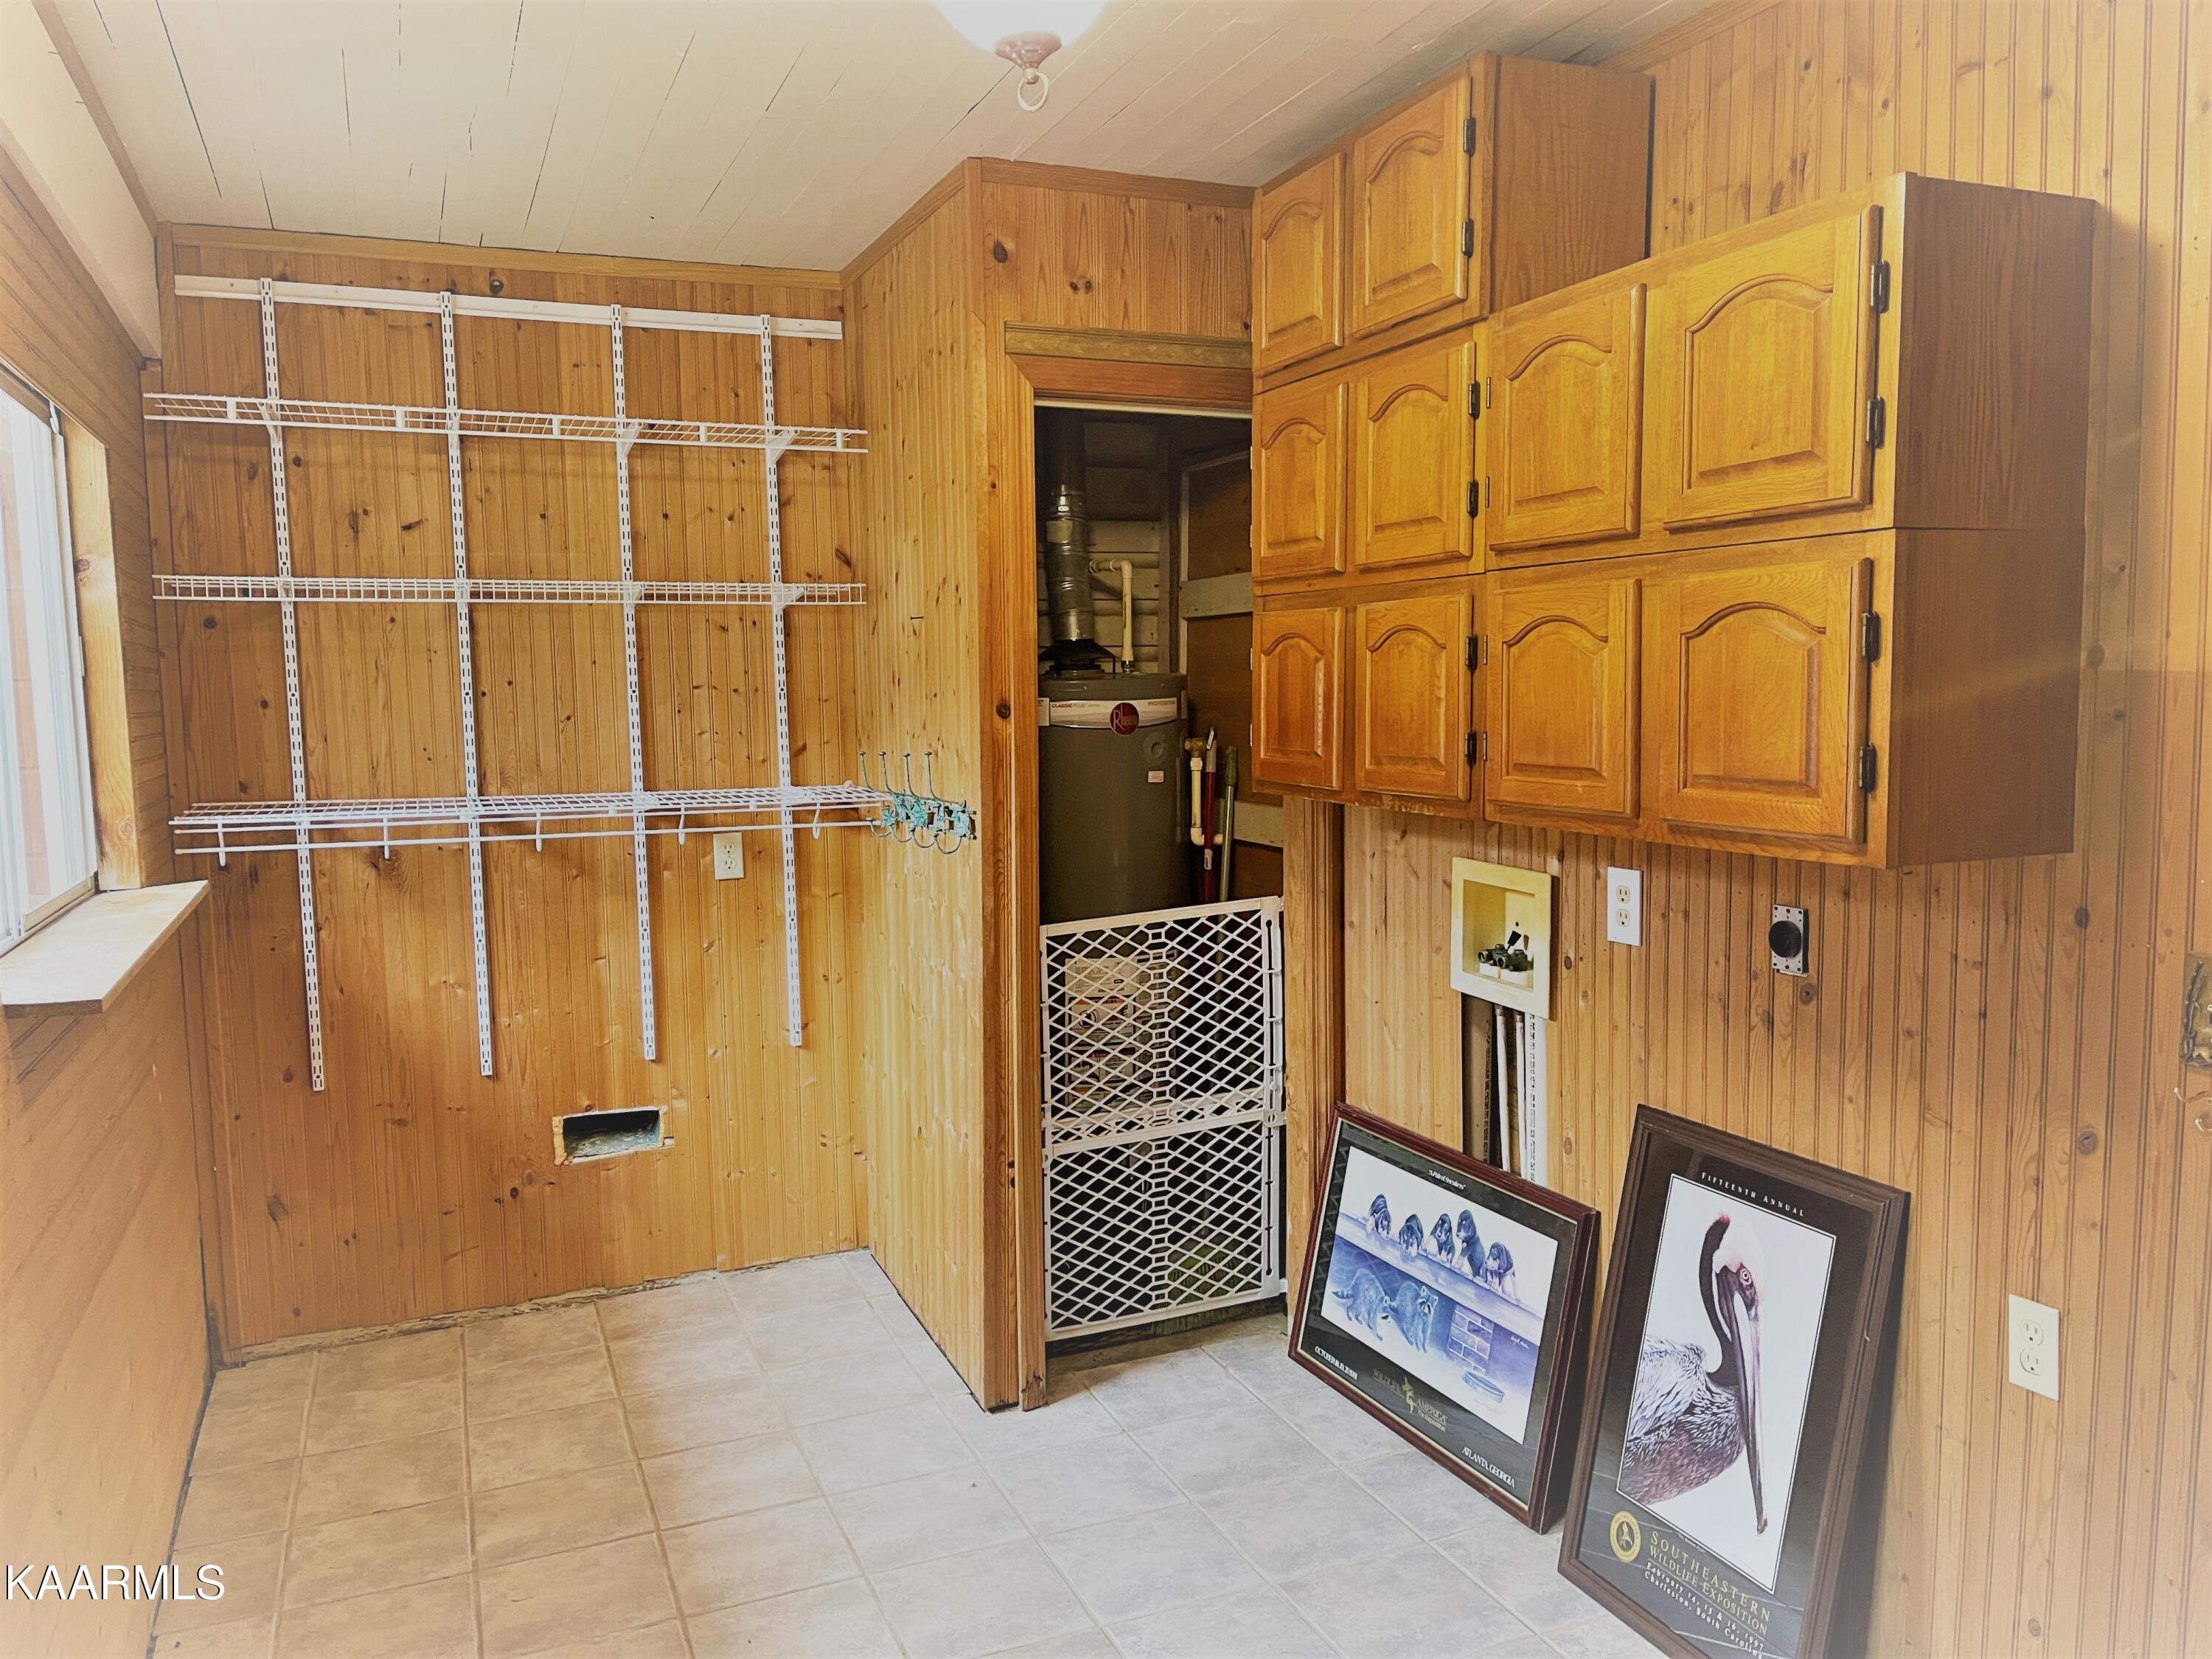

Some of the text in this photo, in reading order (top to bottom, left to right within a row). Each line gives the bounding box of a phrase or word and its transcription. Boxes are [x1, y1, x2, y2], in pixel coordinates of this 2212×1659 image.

[1701, 1172, 1804, 1217] FIFTEENTH ANNUAL
[1415, 1398, 1446, 1425] AMERICA
[1489, 1464, 1515, 1488] GEORGIA
[1650, 1544, 1767, 1635] WILDLIFE EXPOSITION
[1651, 1531, 1770, 1622] SOUTHEASTERN
[1646, 1562, 1684, 1593] February
[1717, 1611, 1722, 1621] &
[1745, 1632, 1764, 1651] 1997
[1697, 1607, 1720, 1630] South
